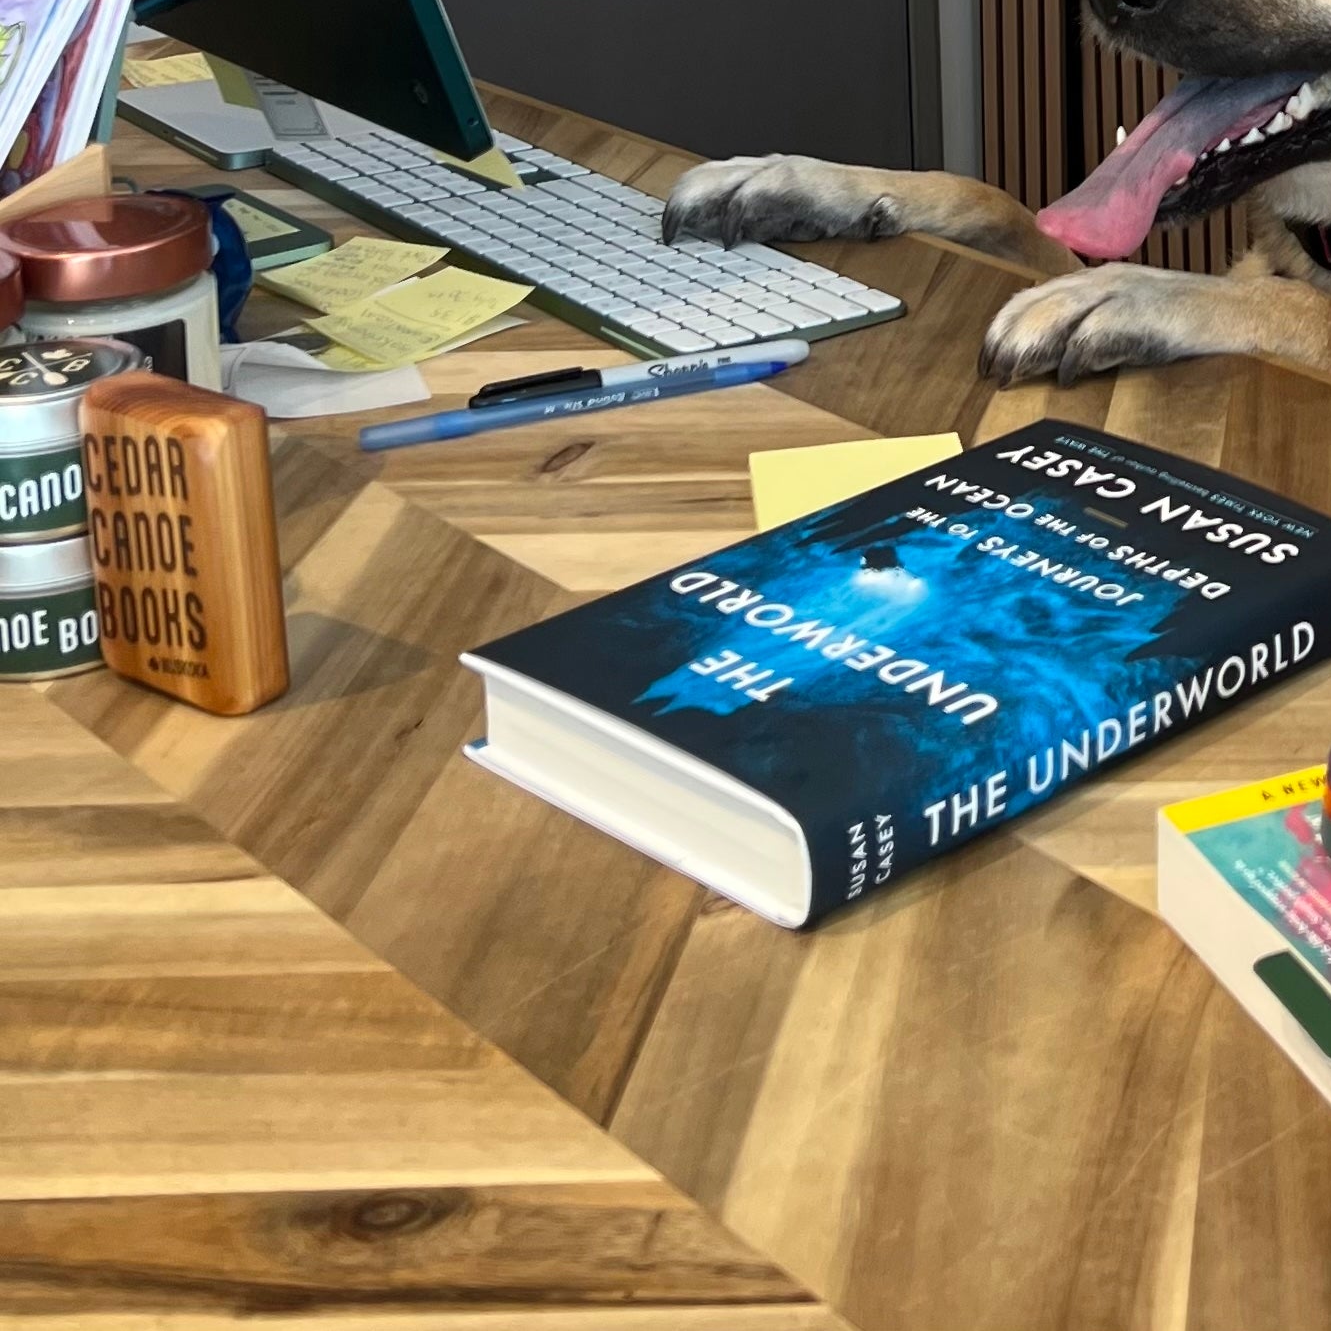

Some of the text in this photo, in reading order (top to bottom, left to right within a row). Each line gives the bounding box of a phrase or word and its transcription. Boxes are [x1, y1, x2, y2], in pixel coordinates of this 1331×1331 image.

[84, 432, 189, 501] CEDAR
[995, 445, 1300, 564] SUSAN CASEY
[93, 508, 197, 578] CANOE
[906, 505, 1144, 606] JOURNEYS TO THE
[923, 473, 1231, 600] DEPTHS OF THE OCEAN
[98, 580, 208, 653] BOOKS
[669, 571, 999, 726] UNDERWORLD
[688, 648, 795, 703] THE
[922, 620, 1317, 847] THE UNDERWORLD
[847, 820, 868, 901] SUSAN
[874, 812, 894, 886] CASEY
